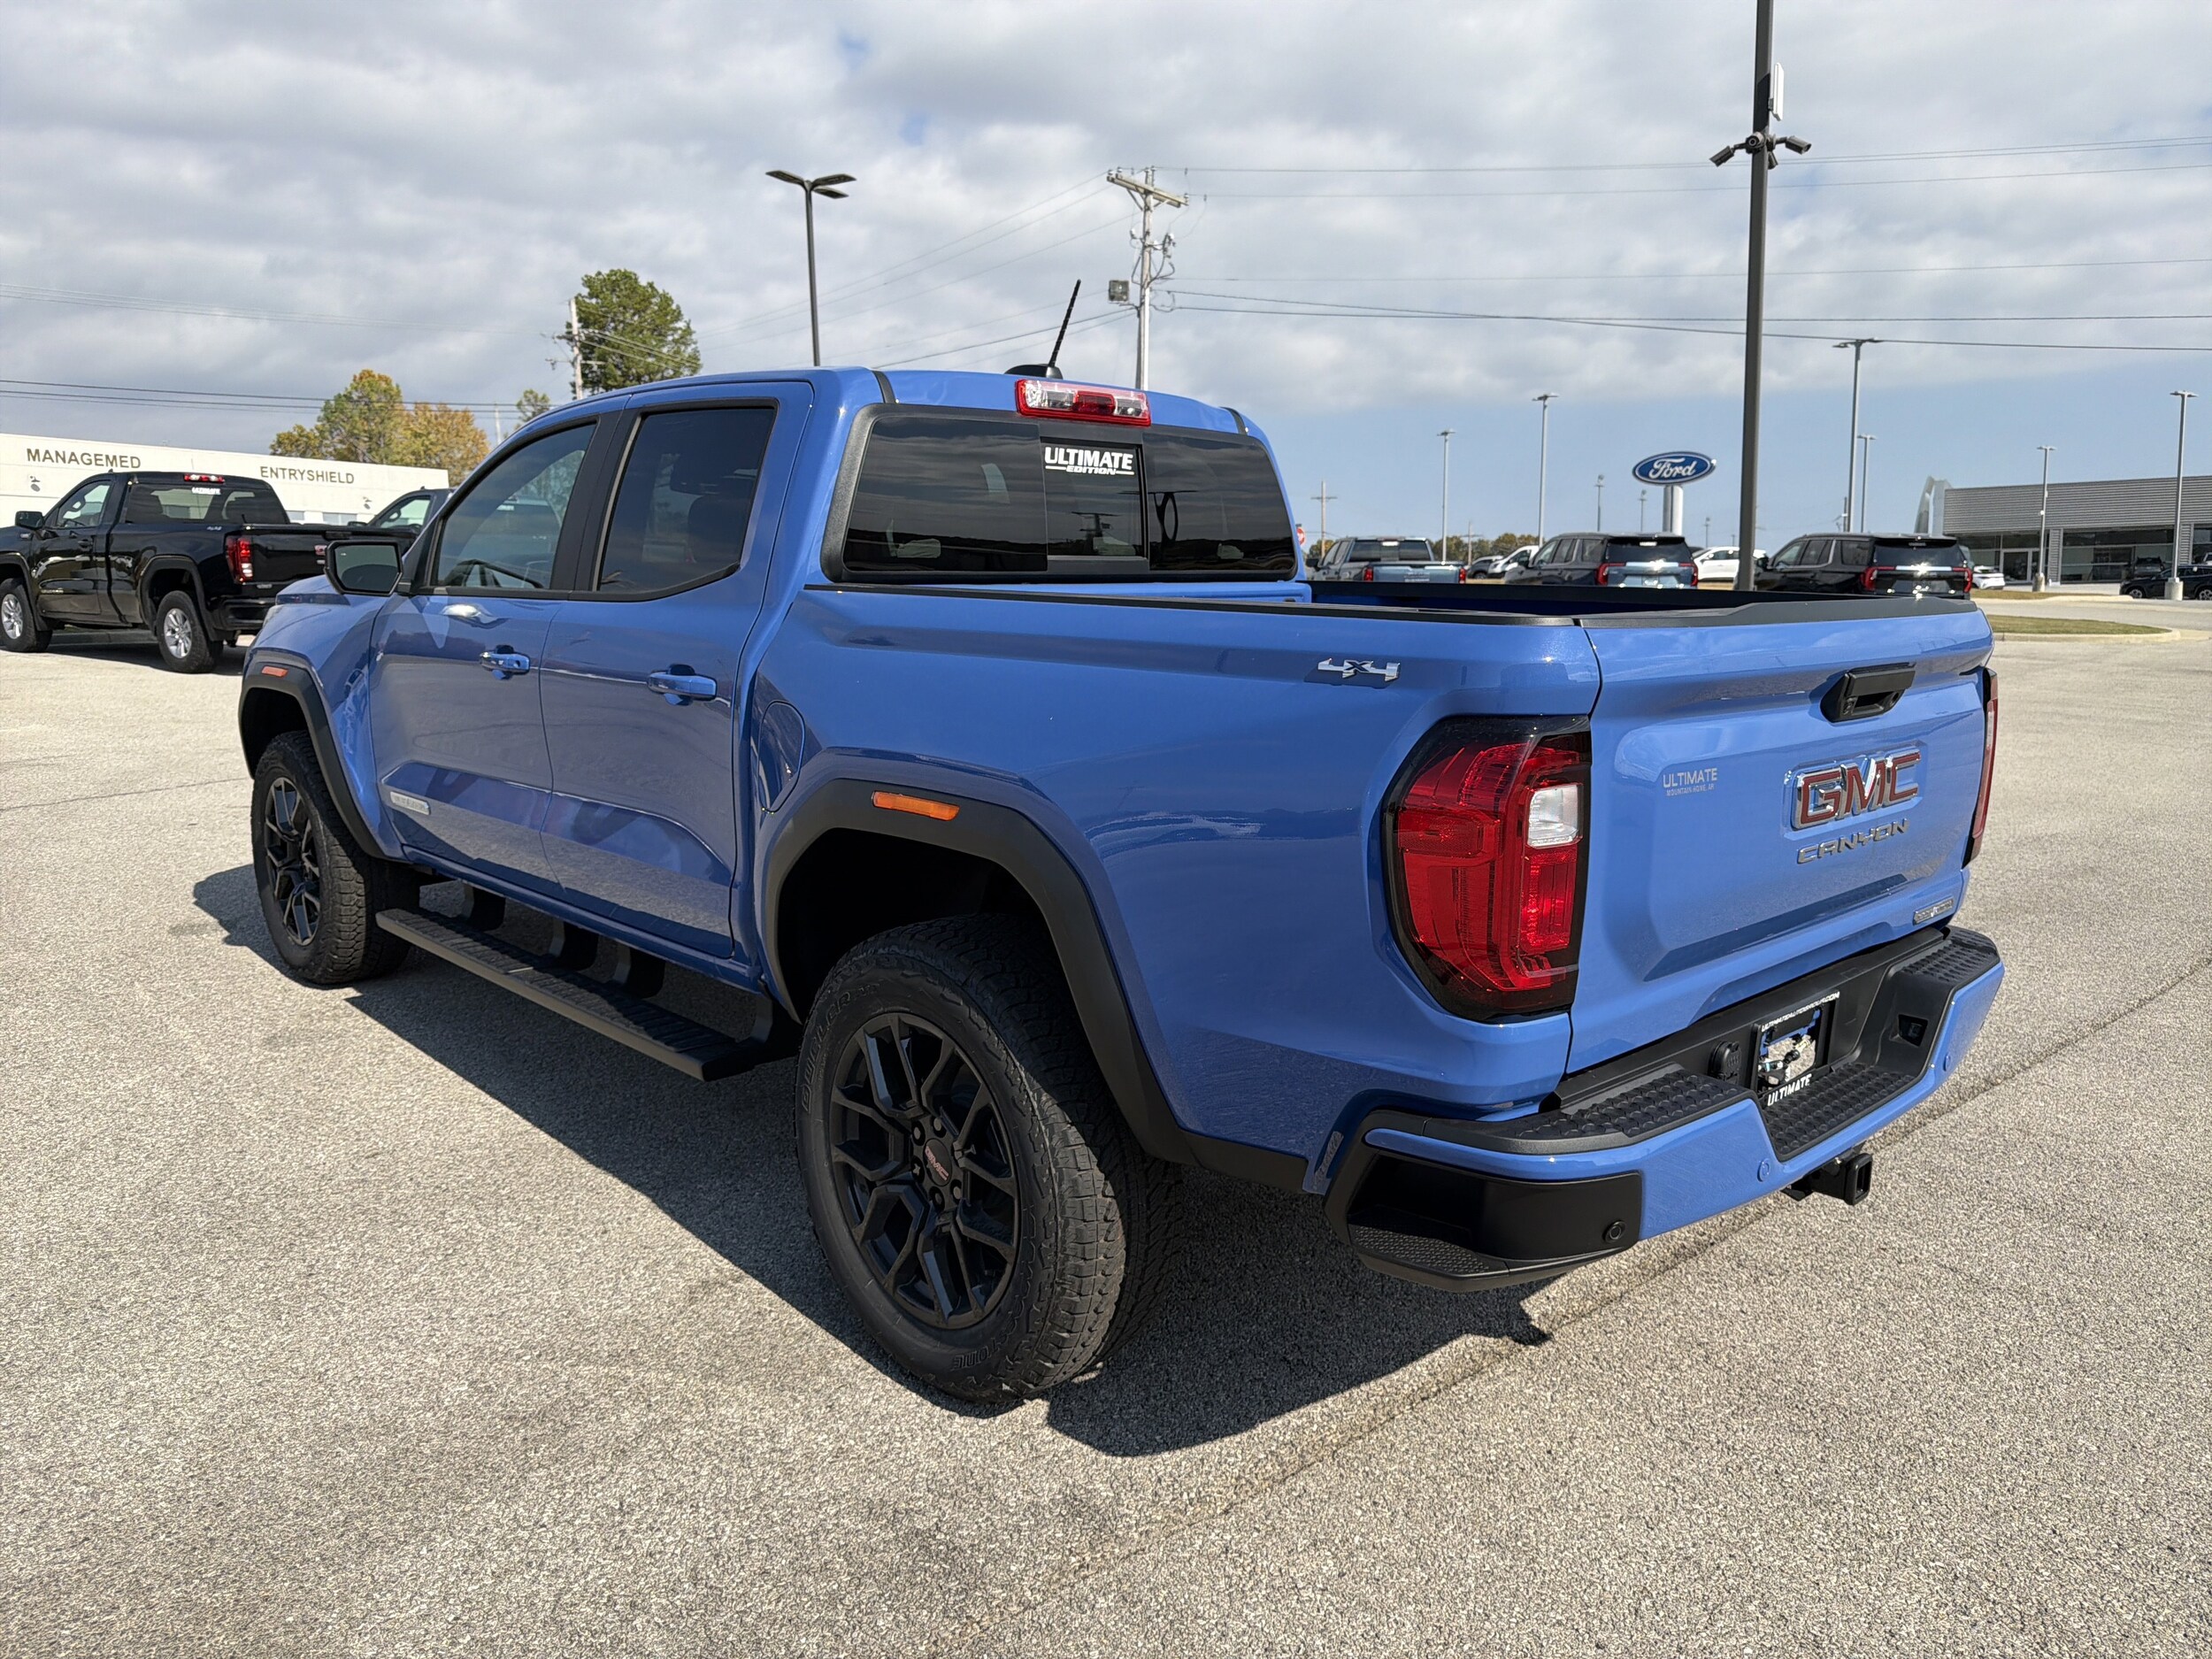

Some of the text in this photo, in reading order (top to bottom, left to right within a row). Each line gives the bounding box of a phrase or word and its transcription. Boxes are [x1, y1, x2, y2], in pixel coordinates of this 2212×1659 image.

[27, 448, 141, 469] MANAGEMED
[1045, 447, 1133, 470] ULTIMATE
[1648, 457, 1697, 479] Ford
[260, 465, 355, 484] ENTRYSHIELD
[1066, 465, 1116, 475] EDITION
[1663, 767, 1718, 788] ULTIMATE
[1666, 786, 1693, 796] MOUNTAIN
[1793, 749, 1921, 830] GMC
[1797, 818, 1909, 864] CANYON
[1768, 1073, 1812, 1106] ULTIMATE
[925, 1145, 949, 1180] GMC
